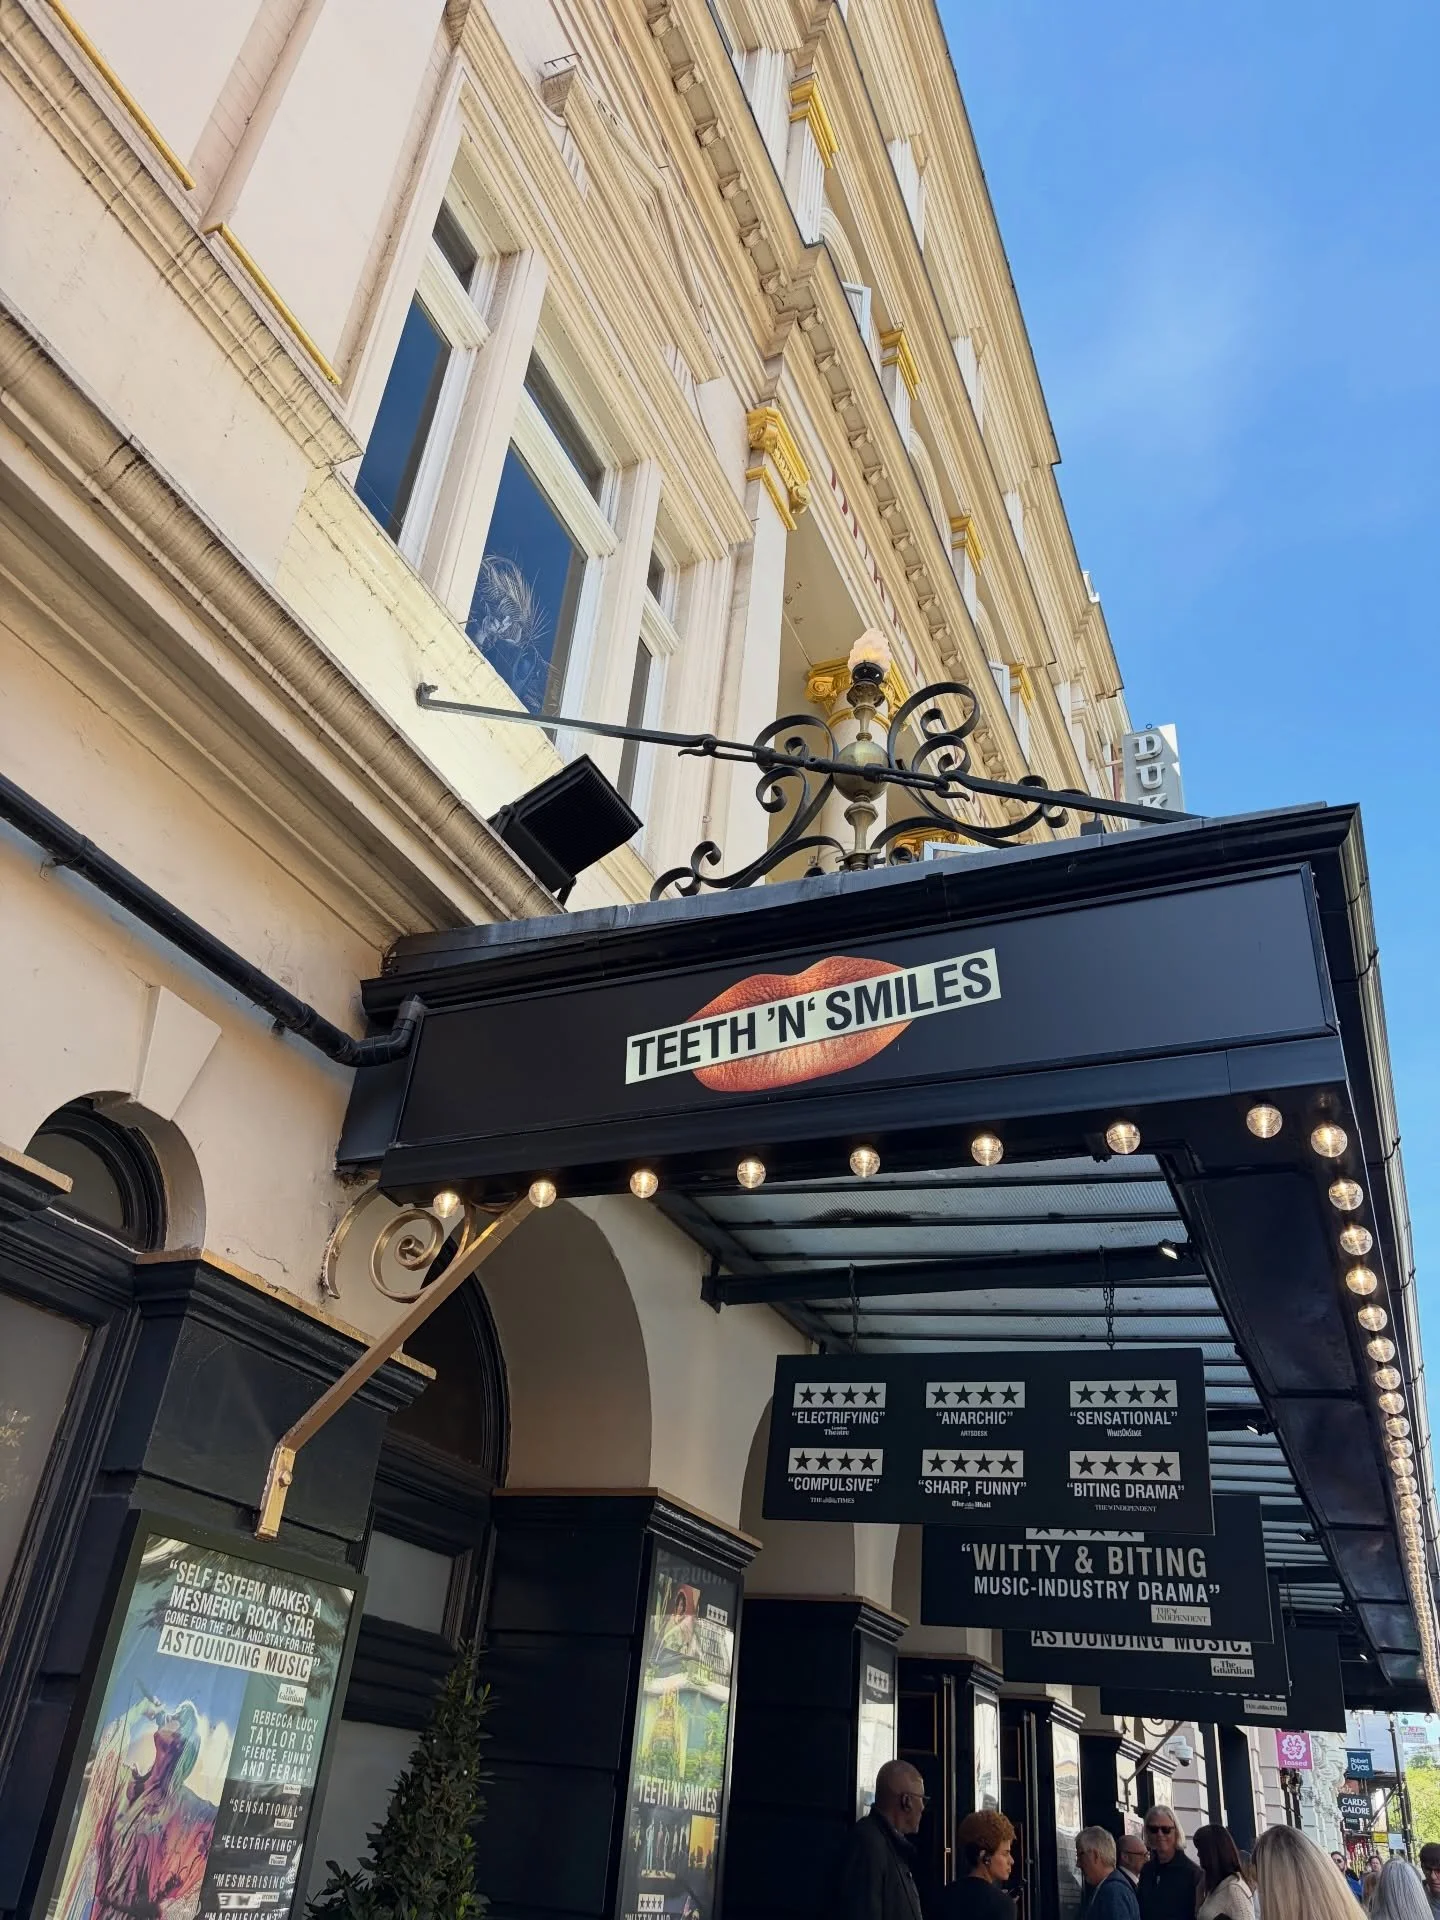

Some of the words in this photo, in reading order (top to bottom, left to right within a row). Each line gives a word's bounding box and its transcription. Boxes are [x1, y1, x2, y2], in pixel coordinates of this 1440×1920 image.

[631, 1012, 756, 1076] TEETH
[826, 957, 992, 1031] SMILES
[791, 1411, 886, 1424] “ELECTRIFYING”
[936, 1411, 1014, 1425] “ANARCHIC”
[1069, 1411, 1178, 1425] “SENSATIONAL”
[788, 1476, 880, 1492] “COMPULSIVE”
[918, 1479, 971, 1497] “SHARP,
[975, 1480, 1027, 1496] FUNNY”
[1066, 1482, 1121, 1498] “BITING
[1125, 1483, 1185, 1500] DRAMA”
[1113, 1504, 1158, 1513] INDEPENDENT
[961, 1542, 1062, 1574] “WITTY
[1074, 1549, 1094, 1575] &
[1108, 1546, 1208, 1579] BITING
[169, 1558, 212, 1589] “SELF
[214, 1571, 266, 1604] ESTEEM
[268, 1586, 311, 1615] MAKES
[312, 1598, 322, 1618] A
[974, 1575, 1130, 1600] MUSIC-INDUSTRY
[1138, 1580, 1221, 1604] DRAMA”
[169, 1585, 243, 1622] MESMERIC
[245, 1604, 282, 1632] ROCK
[283, 1614, 316, 1640] STAR.
[1156, 1614, 1207, 1623] INDEPENDENT
[164, 1610, 189, 1626] COME
[190, 1616, 207, 1630] FOR
[208, 1619, 225, 1634] THE
[226, 1624, 246, 1639] PLAY
[247, 1628, 264, 1642] AND
[264, 1632, 284, 1646] STAY
[285, 1638, 300, 1650] FOR
[301, 1641, 315, 1654] THE
[1034, 1630, 1164, 1650] ASTOUNDING
[161, 1630, 260, 1668] ASTOUNDING
[1213, 1666, 1253, 1676] Guardian
[1220, 1660, 1236, 1668] The
[252, 1709, 293, 1728] REBECCA
[296, 1716, 319, 1733] LUCY
[249, 1726, 296, 1749] TAYLOR
[301, 1734, 314, 1752] IS
[242, 1745, 278, 1764] “FIERCE,
[282, 1750, 311, 1766] FUNNY
[240, 1760, 265, 1777] AND
[1351, 1763, 1370, 1772] Dyas
[638, 1774, 669, 1806] TEETH
[683, 1782, 718, 1814] SMILES
[1342, 1798, 1367, 1806] CARDS
[229, 1798, 302, 1818] “SENSATIONAL”
[1341, 1805, 1370, 1815] GALORE
[222, 1835, 297, 1852] “ELECTRIFYING”
